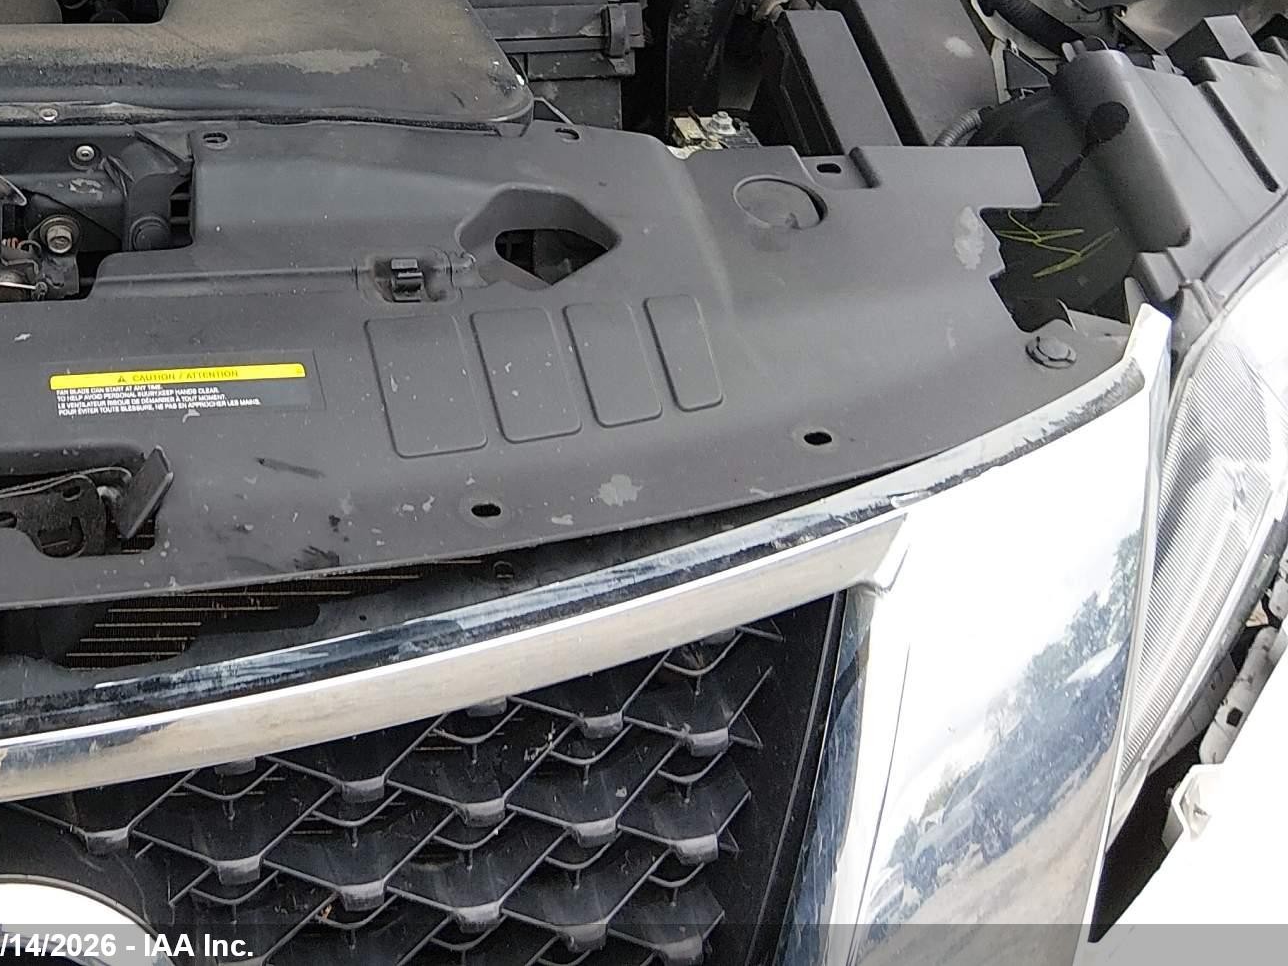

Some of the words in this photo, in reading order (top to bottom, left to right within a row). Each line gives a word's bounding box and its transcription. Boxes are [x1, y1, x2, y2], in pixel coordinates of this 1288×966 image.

[132, 372, 176, 383] CAUTION
[186, 370, 238, 379] ATTENTION
[58, 408, 77, 416] POUR
[77, 406, 99, 415] ÉVITER
[99, 406, 120, 414] TOUTE
[164, 402, 178, 410] PAS
[187, 400, 227, 408] APPROCHER
[227, 399, 239, 407] LES
[66, 400, 106, 409] VENTILATEUR
[107, 398, 130, 407] RISQUE
